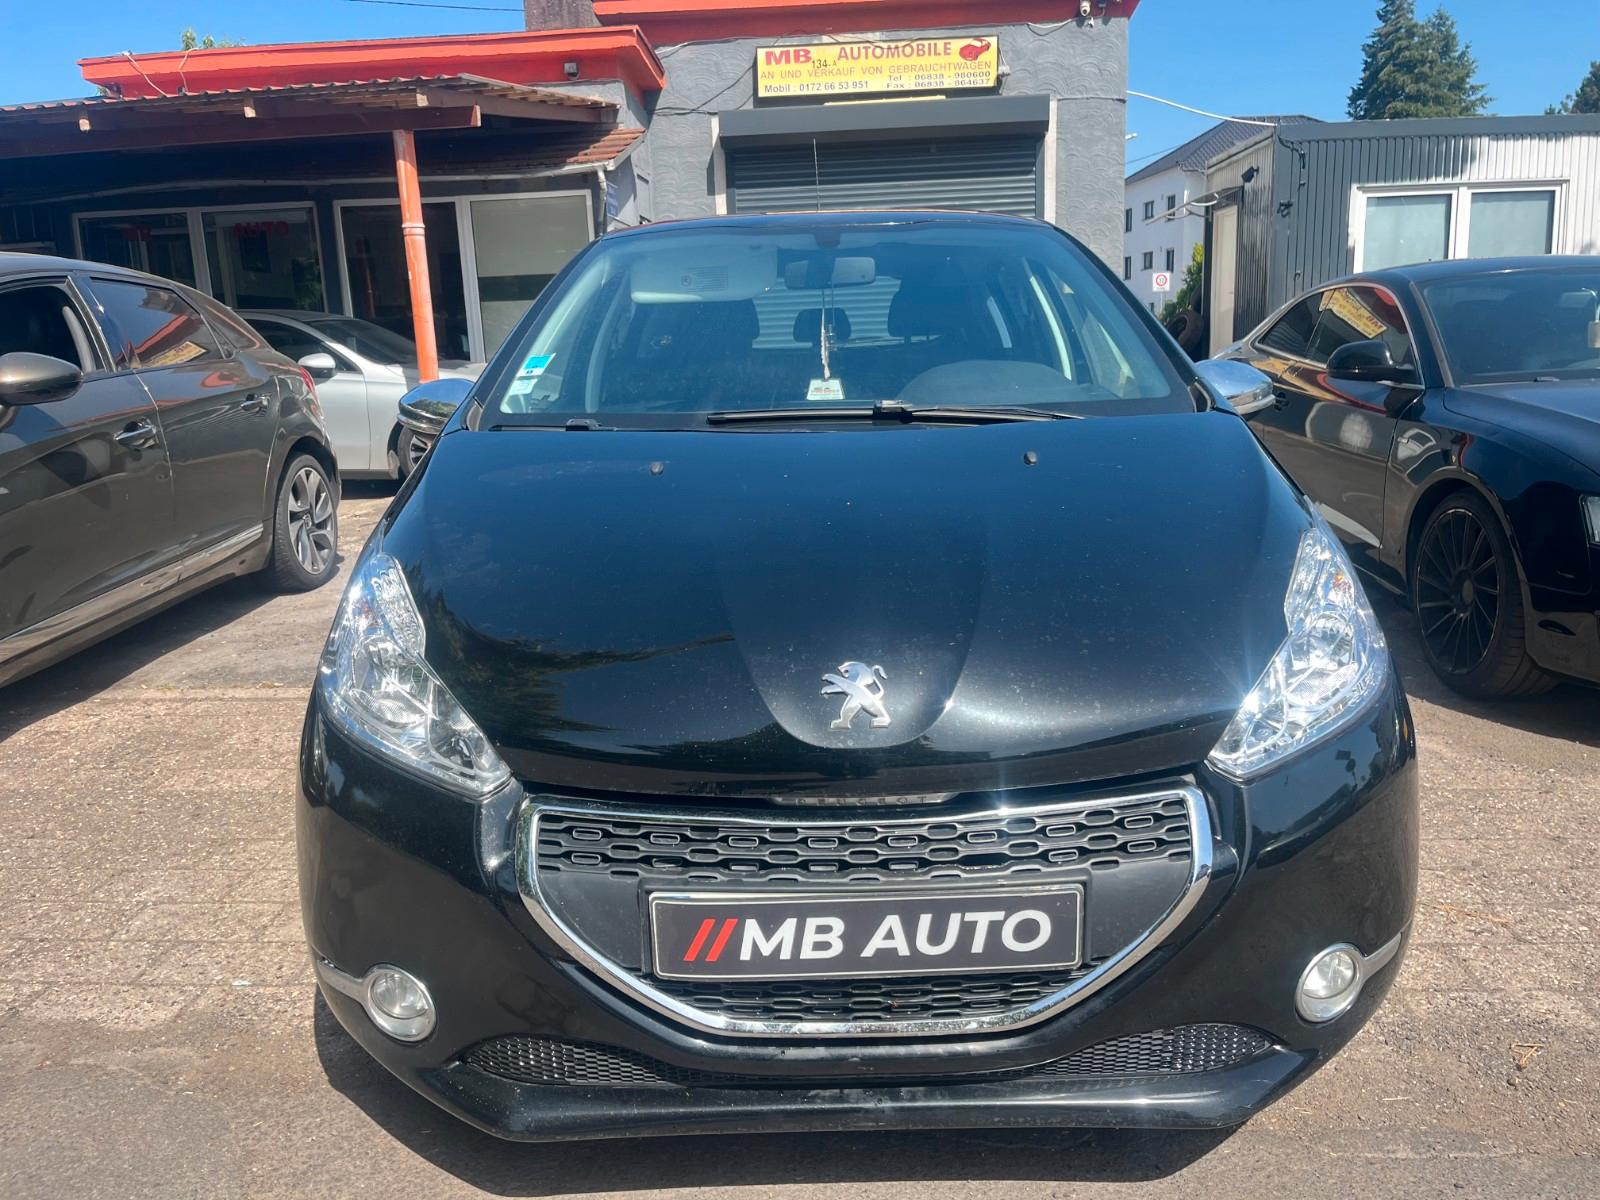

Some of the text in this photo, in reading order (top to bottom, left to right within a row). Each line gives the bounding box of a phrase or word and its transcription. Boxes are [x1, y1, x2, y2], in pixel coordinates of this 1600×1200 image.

[765, 41, 952, 66] MB AUTOMOBILE
[760, 61, 991, 80] AN UND VERKAUF VON GEBRAUCHTWAGEN
[915, 73, 944, 81] 06838
[764, 84, 791, 94] Mobil
[799, 82, 821, 91] 0172
[824, 81, 836, 90] 66
[838, 81, 849, 90] 53
[852, 80, 868, 89] 951
[860, 910, 1052, 958] AUTO
